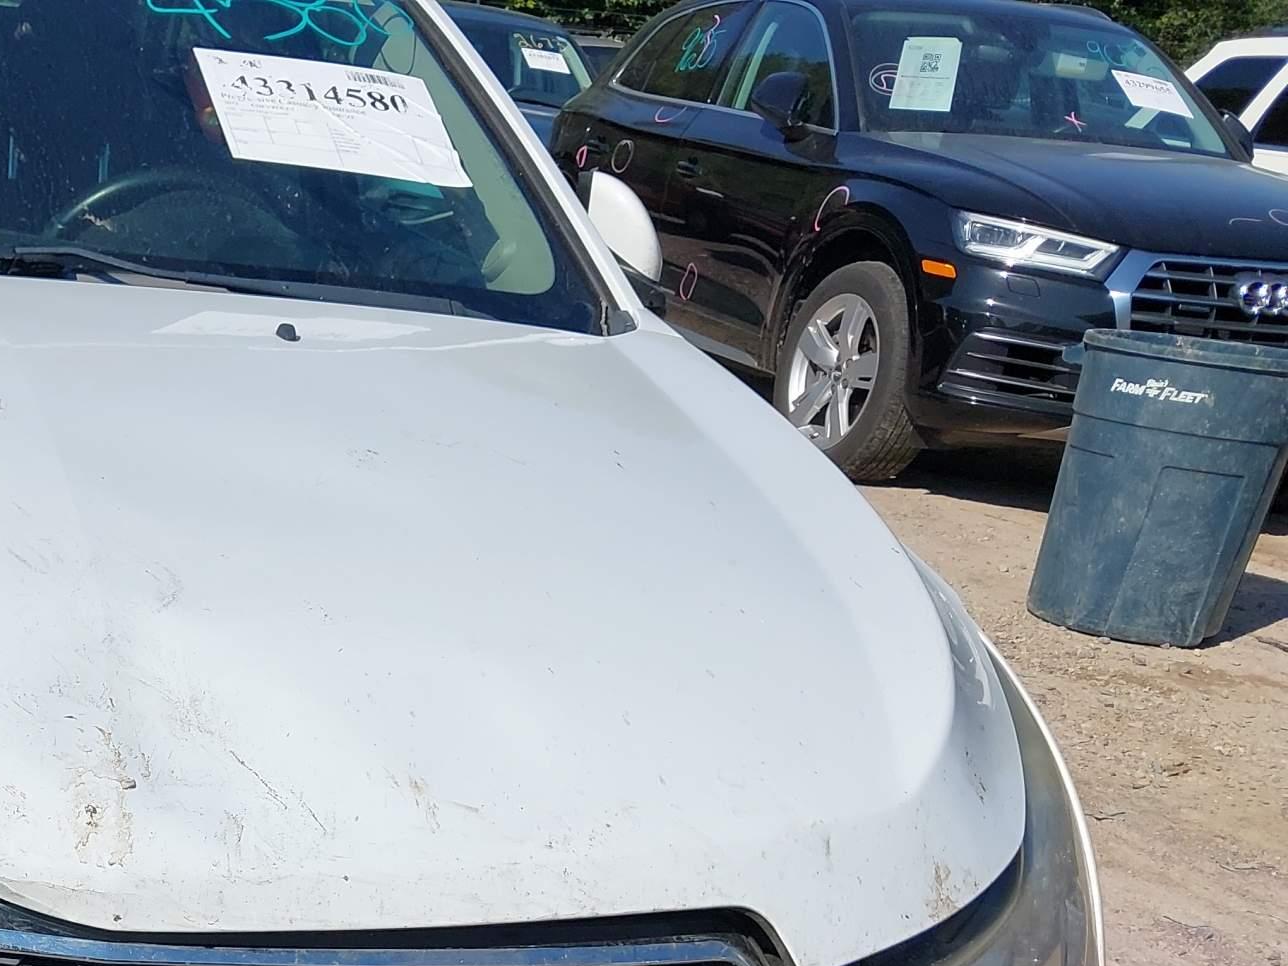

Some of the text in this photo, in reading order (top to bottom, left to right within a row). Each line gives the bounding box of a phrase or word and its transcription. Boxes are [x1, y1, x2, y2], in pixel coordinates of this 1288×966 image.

[230, 75, 410, 114] 43314580
[1110, 377, 1146, 395] FARM
[1159, 387, 1207, 404] FLEET
